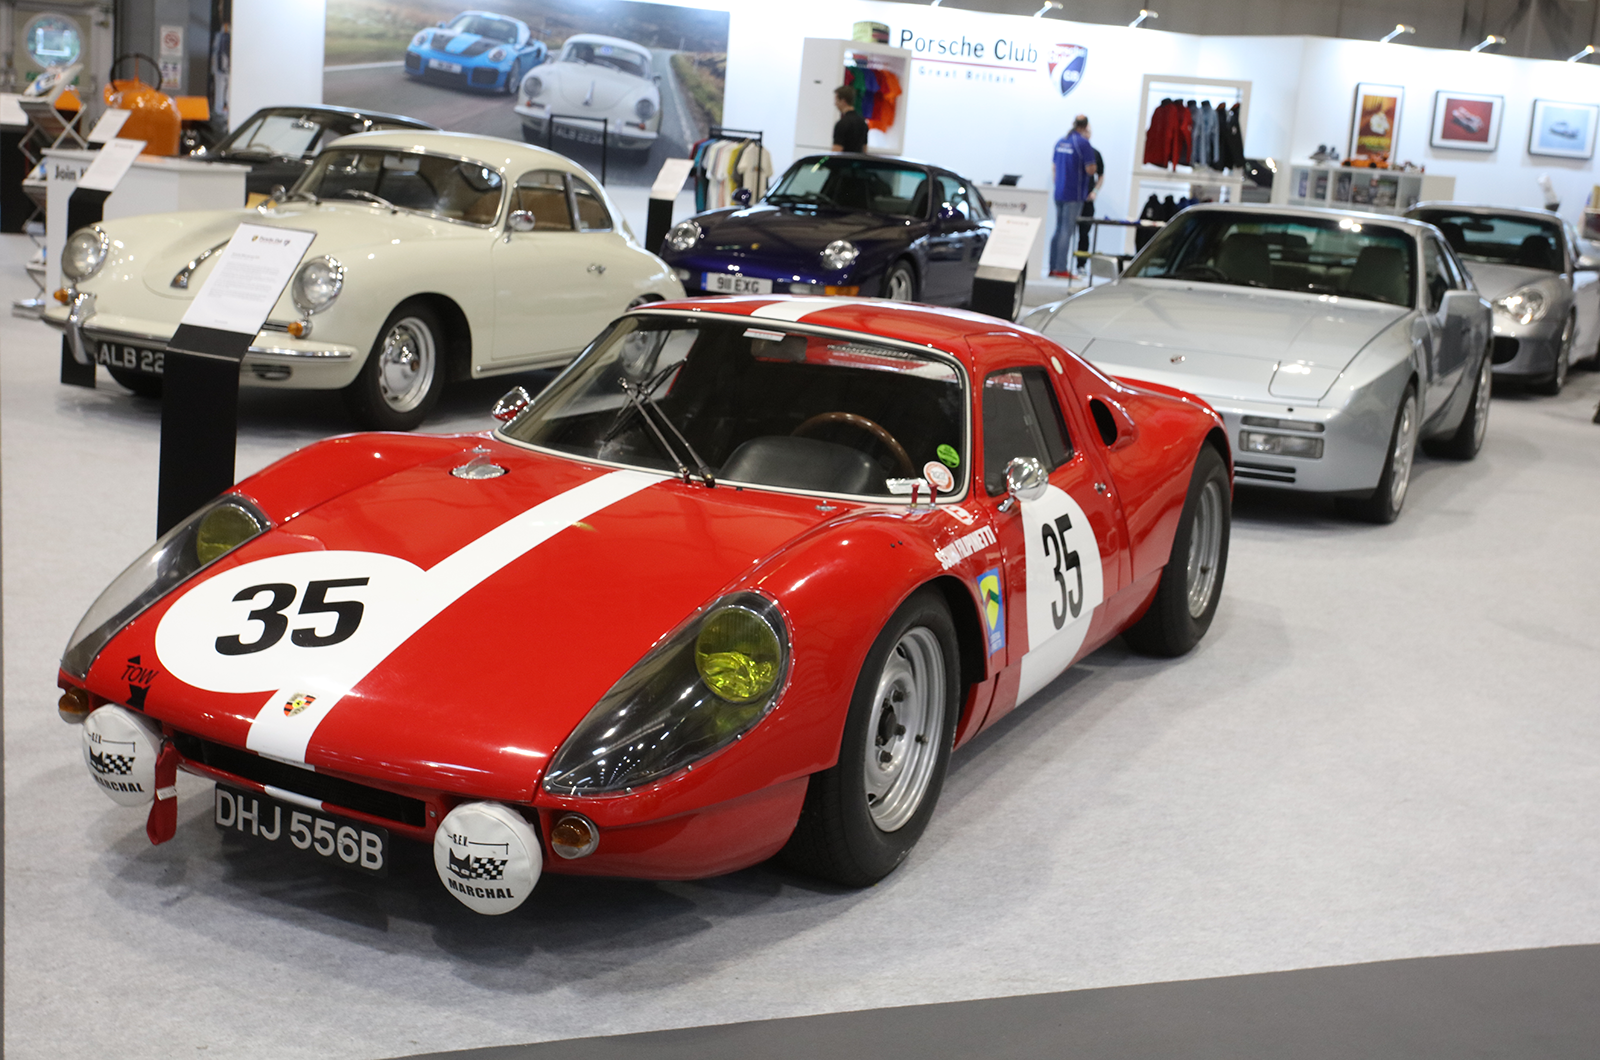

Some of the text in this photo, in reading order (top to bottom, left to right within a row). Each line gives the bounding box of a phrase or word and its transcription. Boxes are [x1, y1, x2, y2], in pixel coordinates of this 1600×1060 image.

[900, 29, 984, 58] Porsche
[994, 39, 1038, 63] Club
[918, 66, 1015, 83] Great Britain
[55, 165, 76, 180] Join
[734, 279, 760, 293] EXG
[99, 343, 137, 368] ALB
[1042, 513, 1084, 630] 35
[215, 577, 370, 655] 35
[121, 665, 160, 685] TOW
[92, 772, 145, 793] MARCHAL
[216, 788, 383, 870] DHJ 556B
[447, 877, 515, 899] MARCHAL
